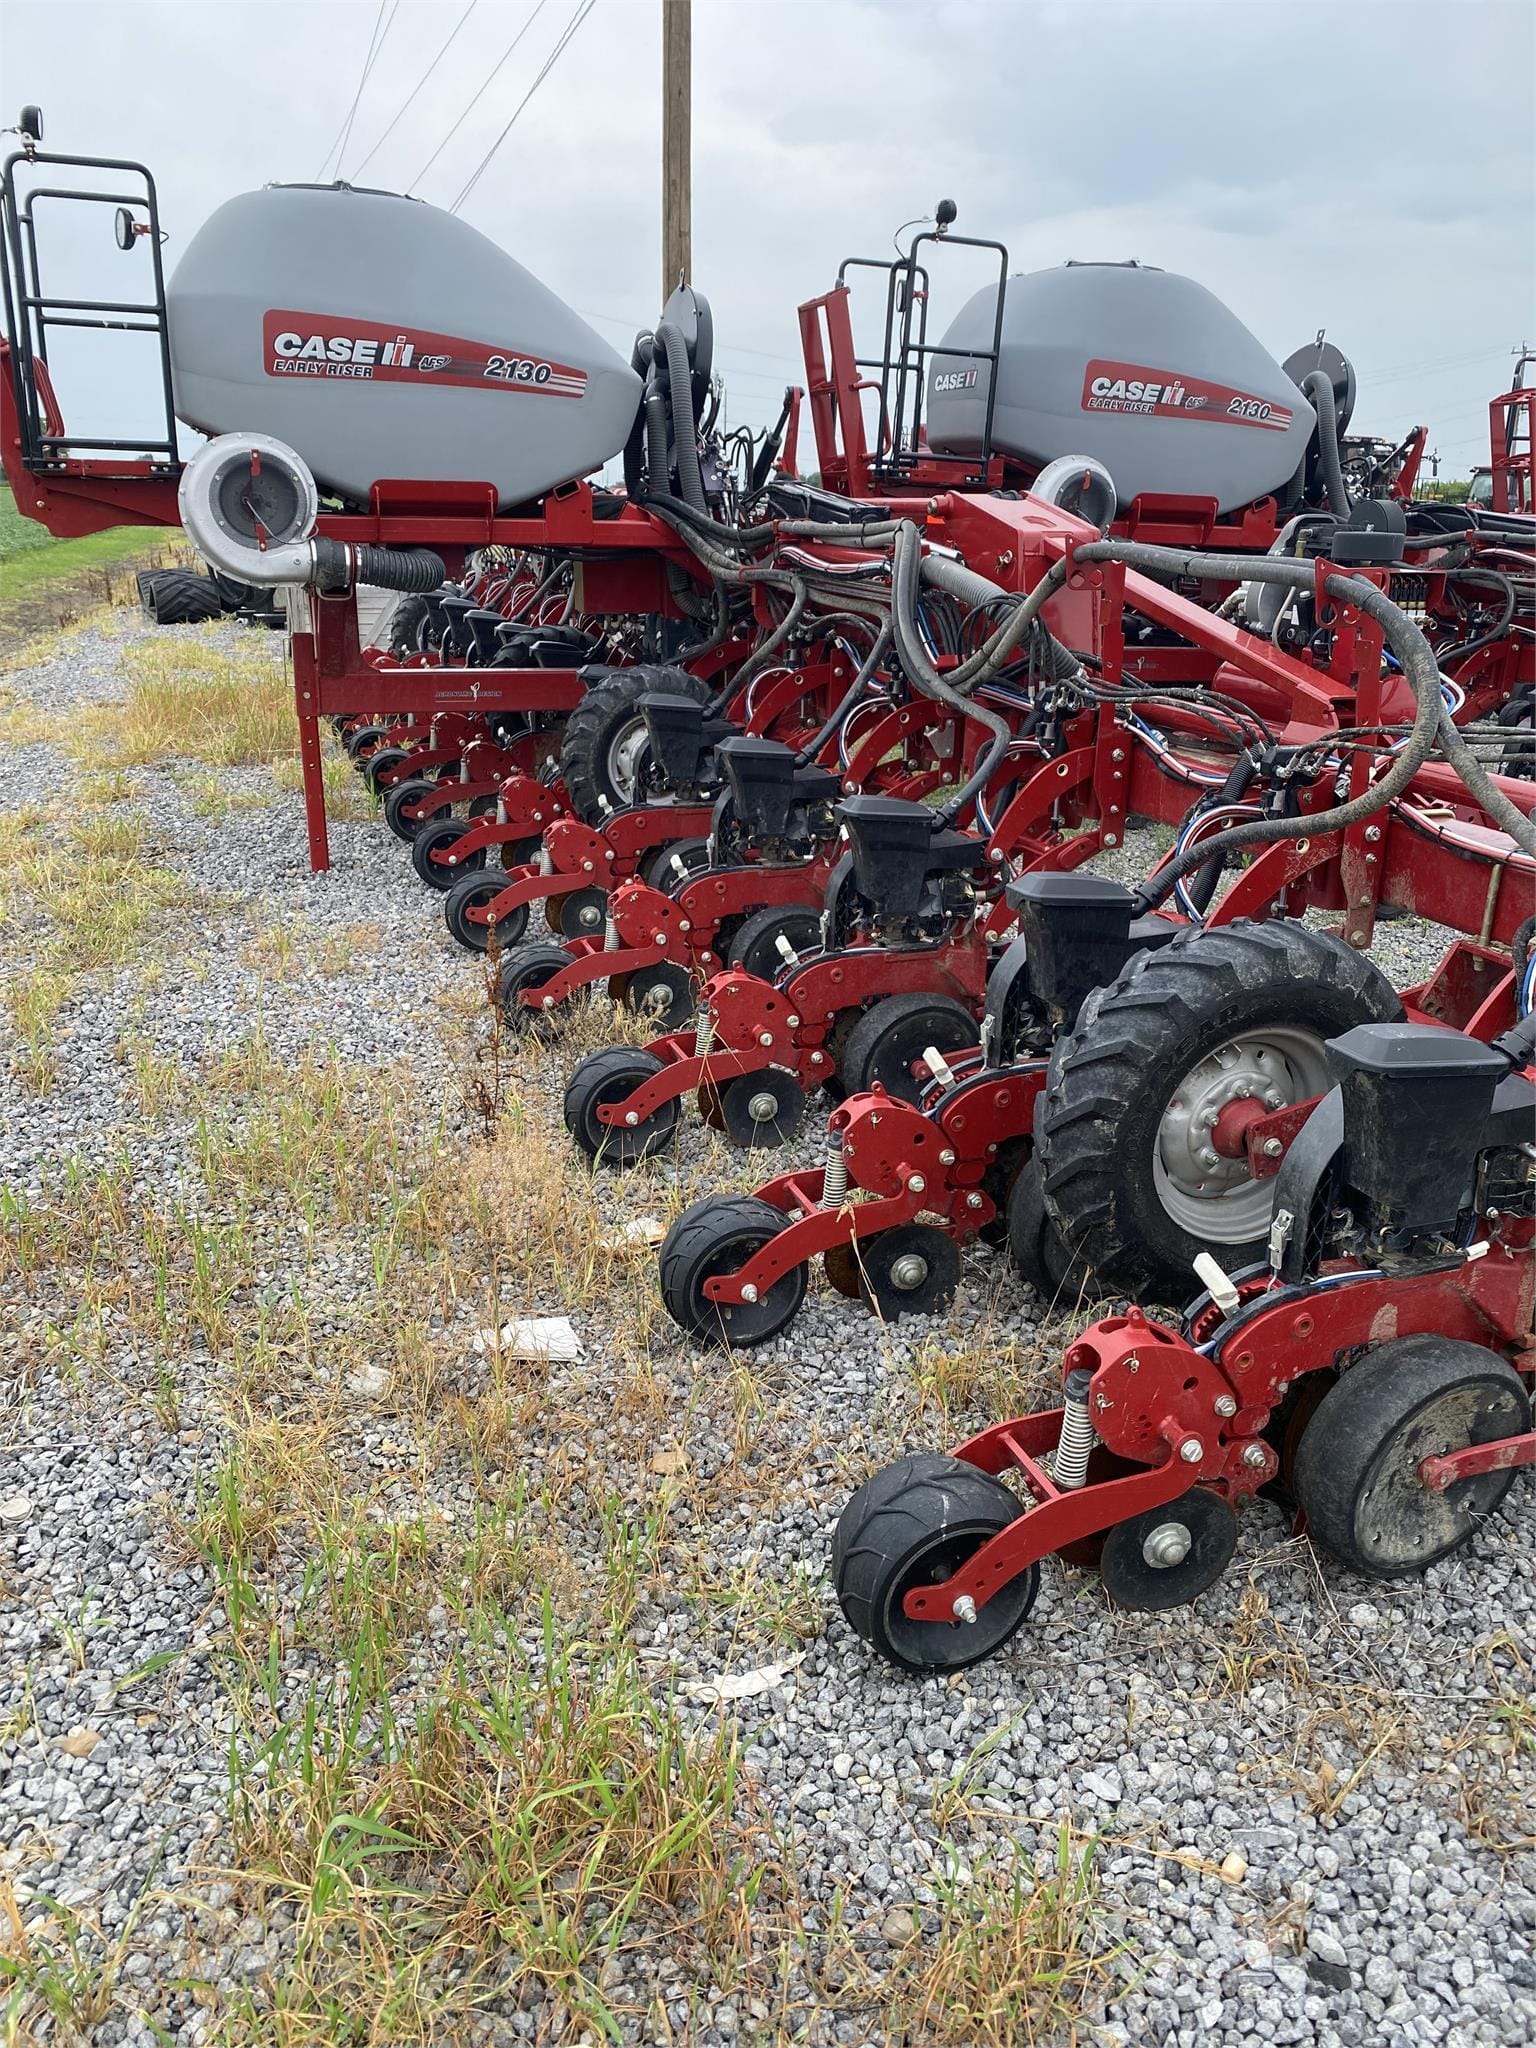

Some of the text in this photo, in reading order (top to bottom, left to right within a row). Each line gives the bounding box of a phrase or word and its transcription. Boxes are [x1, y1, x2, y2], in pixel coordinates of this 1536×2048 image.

[274, 332, 379, 364] CASE
[273, 359, 373, 378] EARLY RISER
[420, 355, 446, 370] AFS
[484, 355, 553, 384] 2130
[935, 372, 966, 391] CASE
[1091, 377, 1162, 403] CASE
[1088, 397, 1155, 414] EARLY RISER
[1226, 397, 1272, 420] 2130
